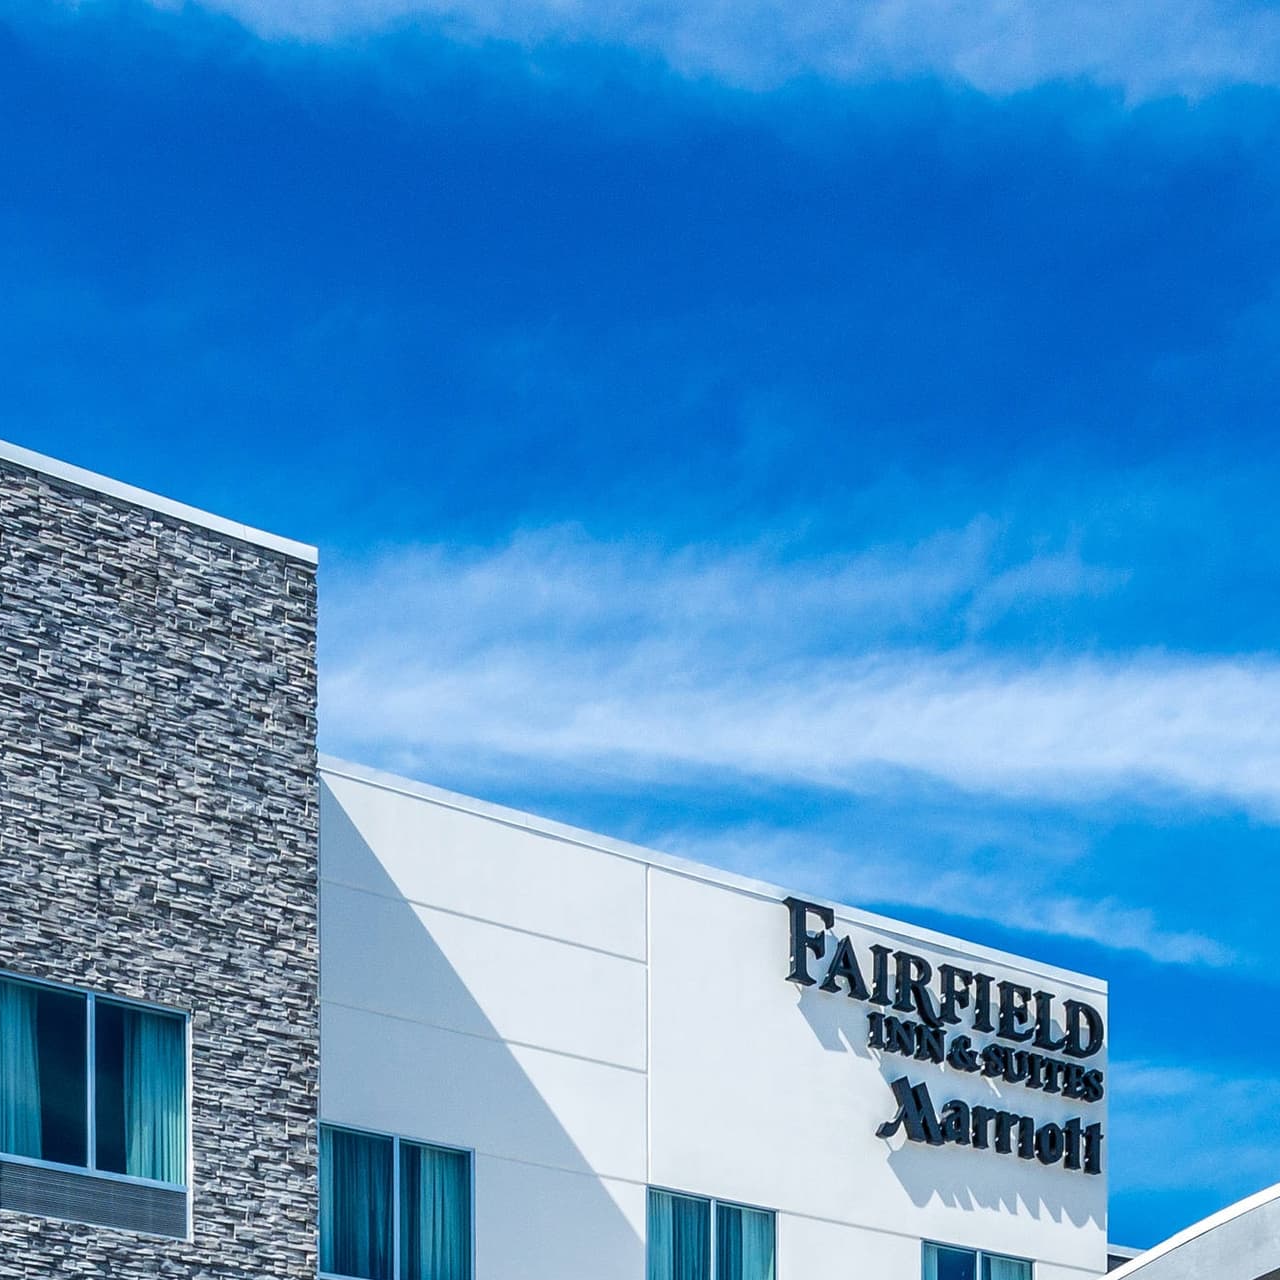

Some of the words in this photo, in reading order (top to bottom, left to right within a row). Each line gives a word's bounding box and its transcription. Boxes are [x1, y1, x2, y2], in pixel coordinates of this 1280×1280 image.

[782, 896, 1104, 1059] FAIRFIELD
[867, 1011, 947, 1064] INN
[946, 1035, 982, 1073] &
[980, 1043, 1104, 1103] SUITES
[875, 1076, 1104, 1175] Marriott
